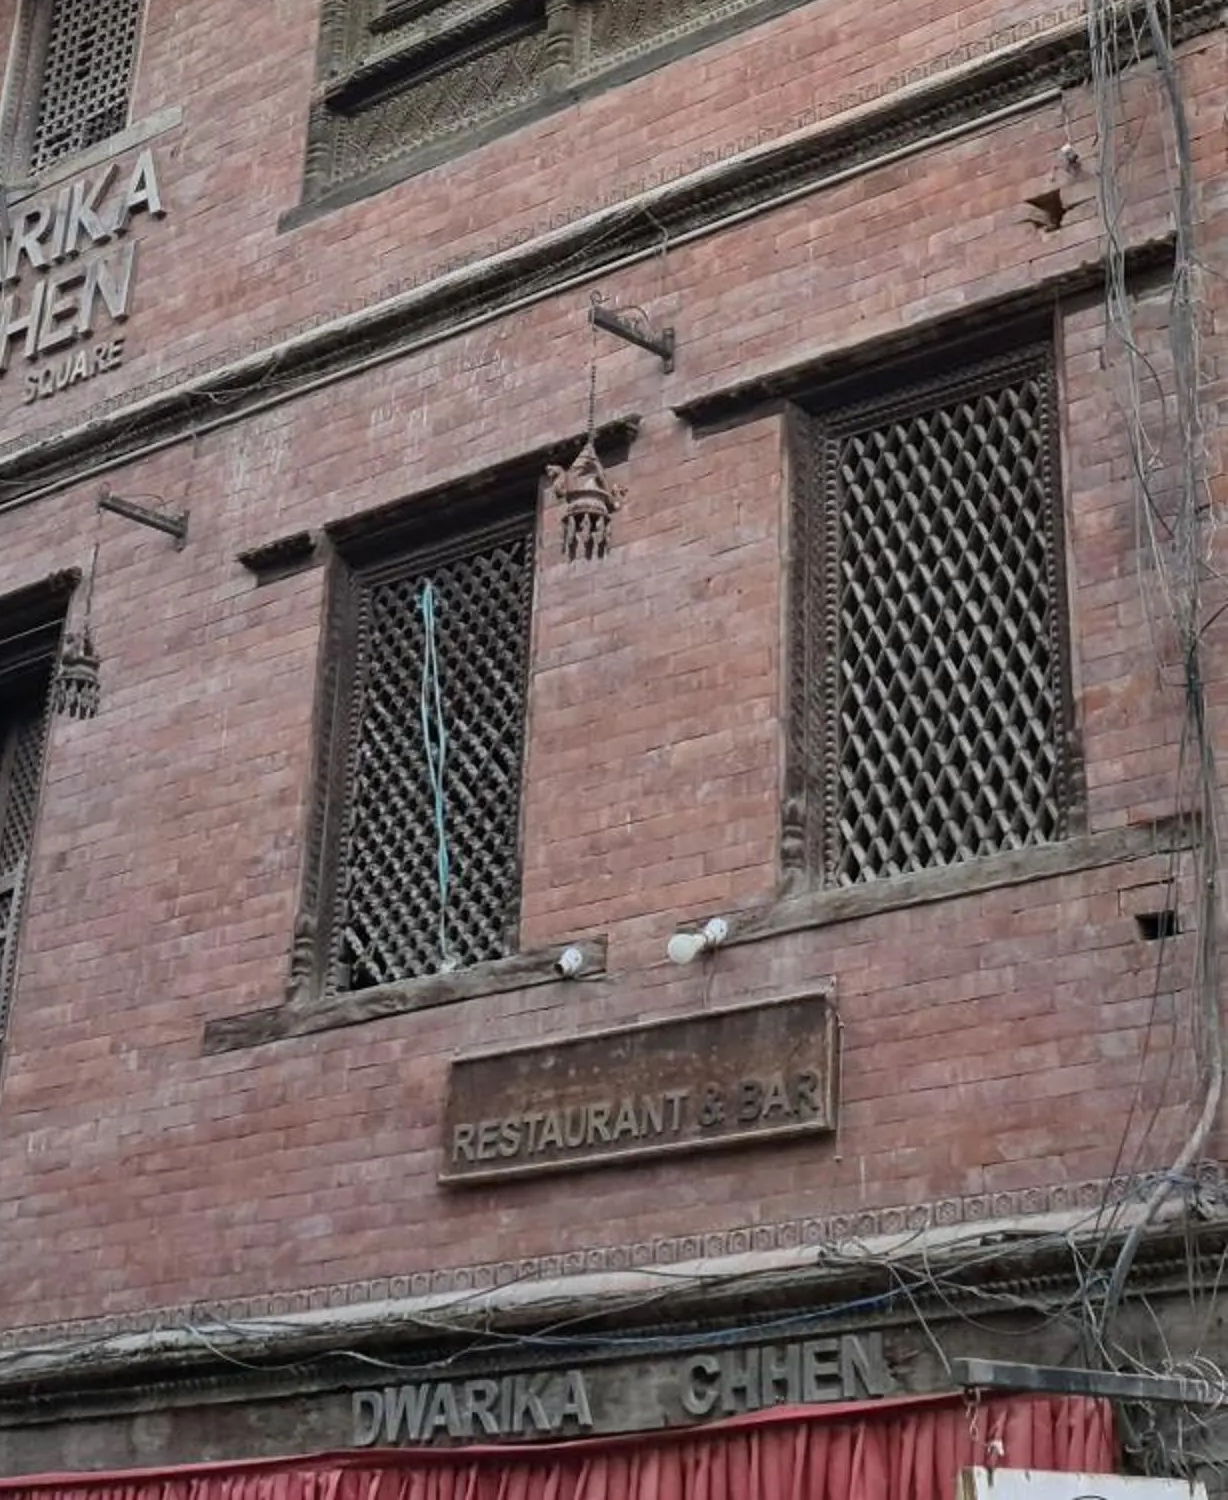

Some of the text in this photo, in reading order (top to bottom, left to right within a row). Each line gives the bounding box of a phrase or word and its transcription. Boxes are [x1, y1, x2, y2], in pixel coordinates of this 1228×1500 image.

[22, 337, 126, 405] SQUARE
[451, 1068, 823, 1164] RESTAURANT & BAR
[350, 1331, 893, 1447] DWARIKA CHHEN
